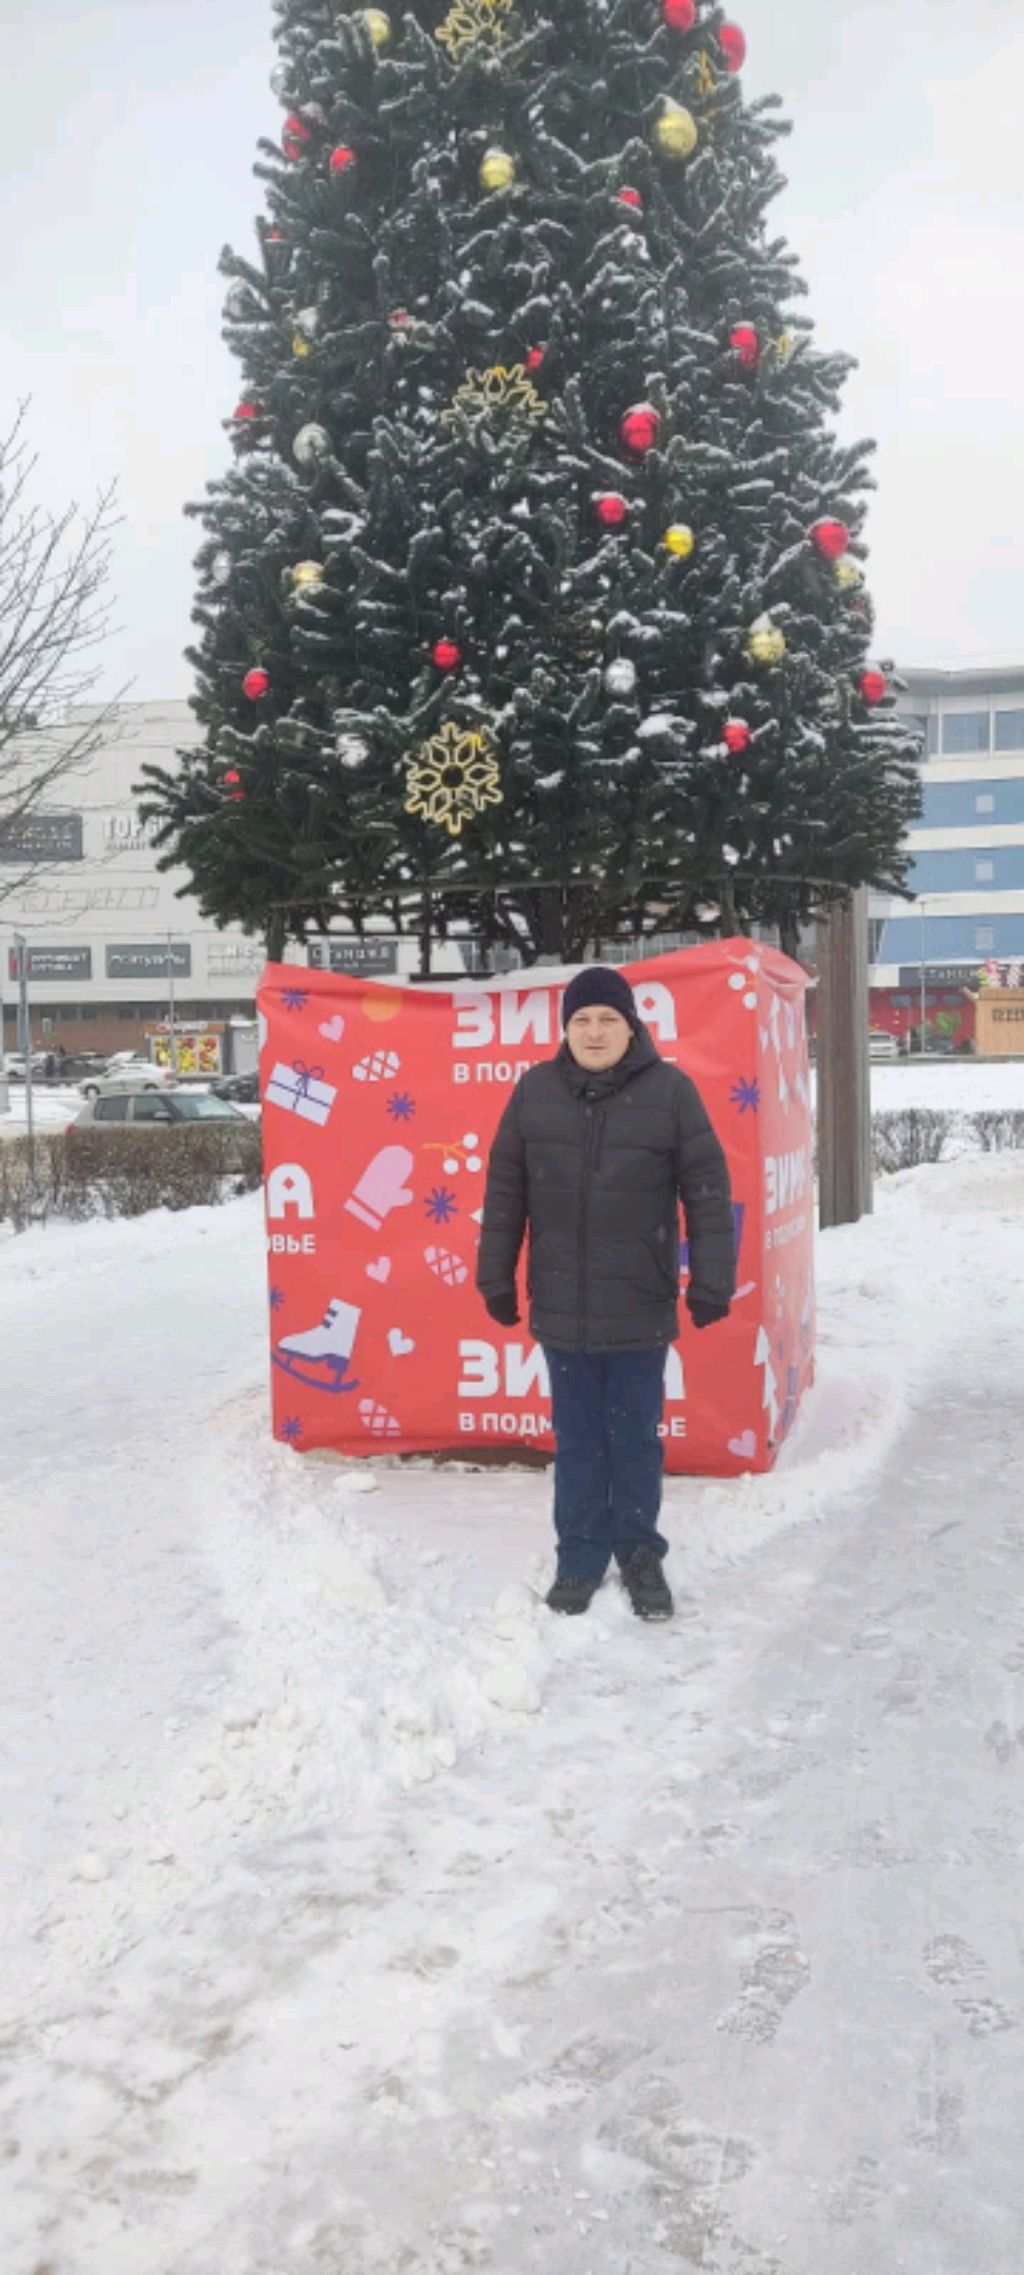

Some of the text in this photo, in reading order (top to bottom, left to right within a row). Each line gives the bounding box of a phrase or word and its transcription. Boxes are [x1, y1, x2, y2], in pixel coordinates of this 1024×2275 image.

[452, 981, 677, 1048] ЗИА
[454, 1064, 470, 1084] В
[459, 1412, 476, 1431] В
